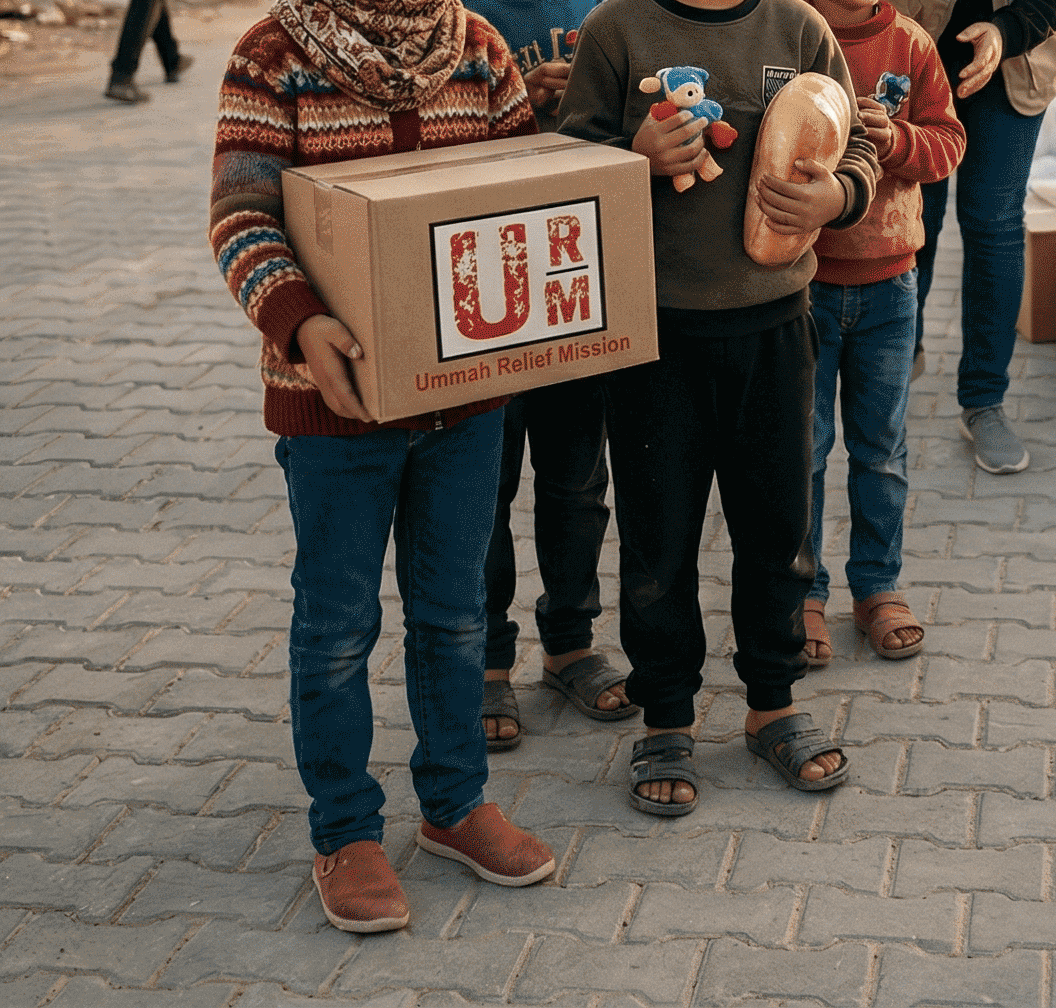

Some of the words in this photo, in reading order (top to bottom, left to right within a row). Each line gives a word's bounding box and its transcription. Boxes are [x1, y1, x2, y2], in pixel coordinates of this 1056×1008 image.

[449, 214, 591, 341] URM
[414, 361, 491, 392] Ummah
[496, 347, 553, 377] Relief
[558, 336, 631, 364] Mission
